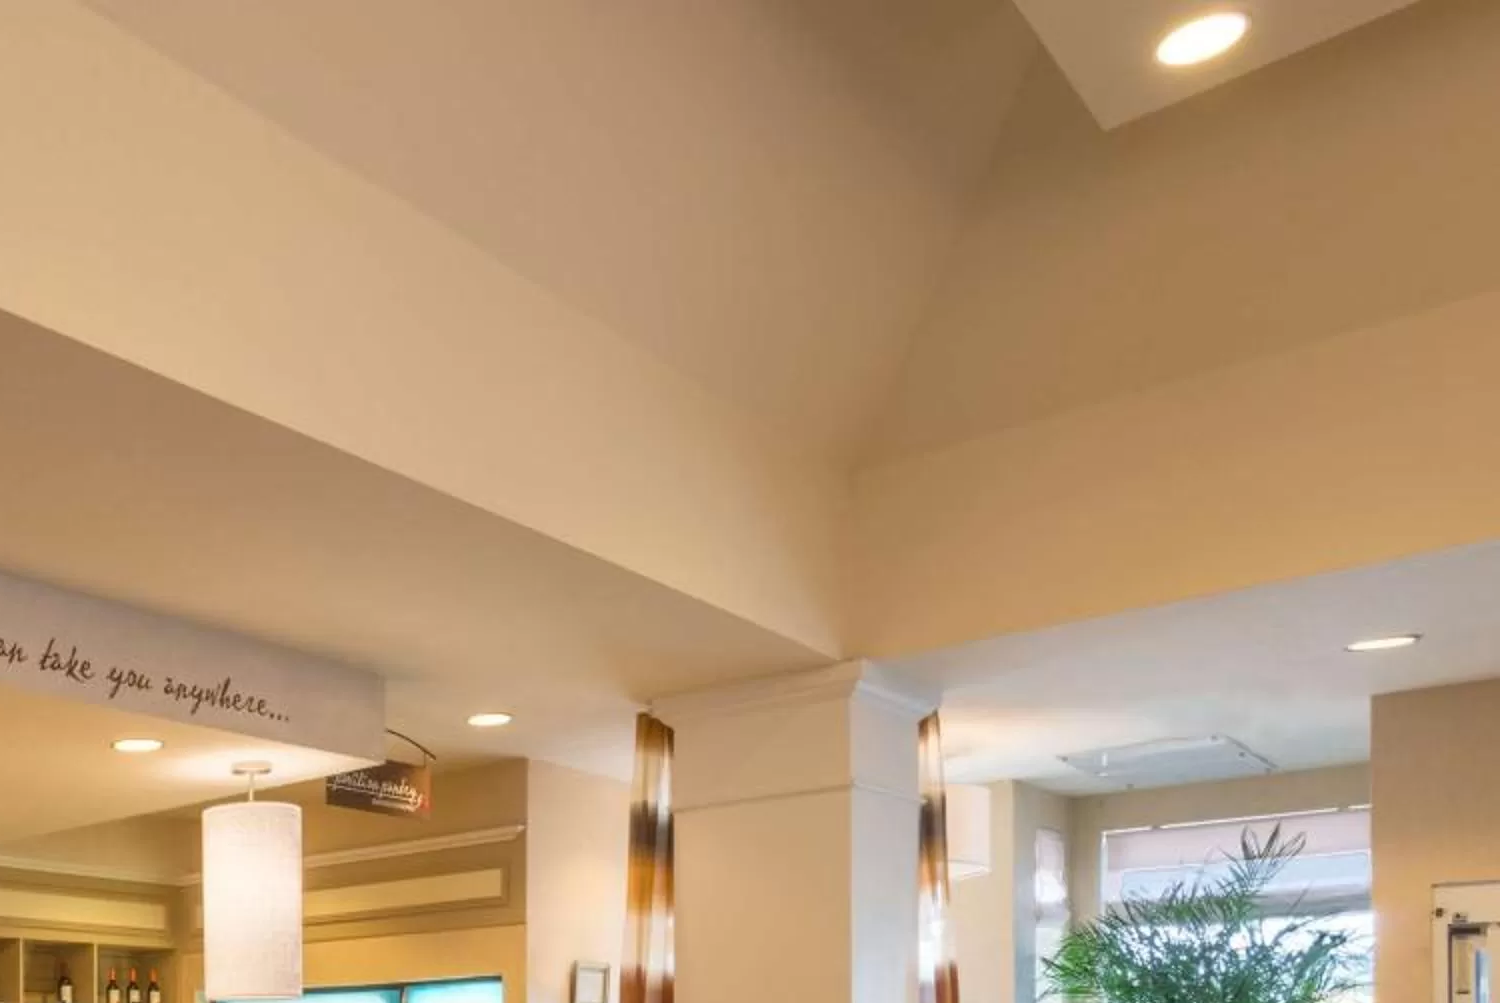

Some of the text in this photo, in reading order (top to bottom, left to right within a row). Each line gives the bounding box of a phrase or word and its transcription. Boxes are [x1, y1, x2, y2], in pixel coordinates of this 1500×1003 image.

[38, 637, 95, 684] take
[105, 667, 153, 700] you
[163, 677, 290, 722] anywhere...
